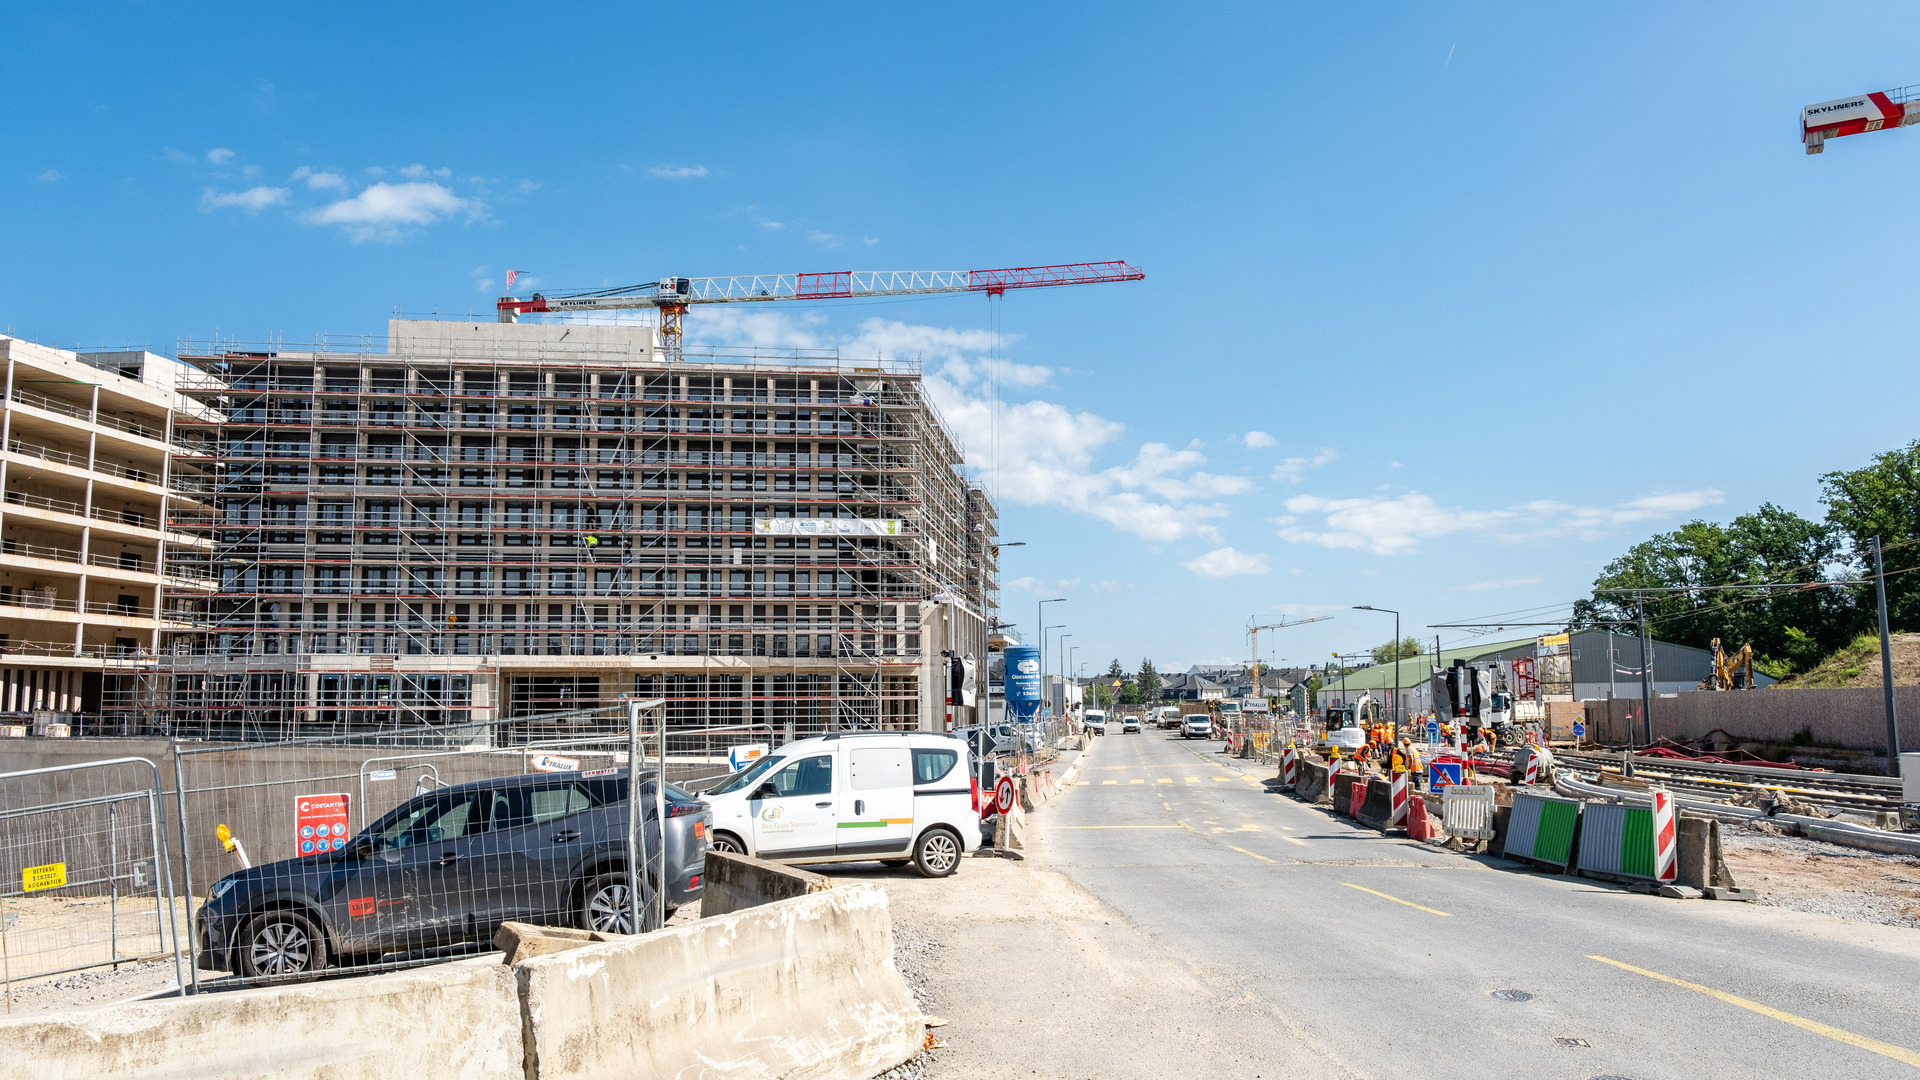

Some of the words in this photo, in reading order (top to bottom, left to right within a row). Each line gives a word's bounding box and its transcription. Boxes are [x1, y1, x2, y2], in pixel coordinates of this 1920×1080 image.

[1807, 100, 1865, 115] SKYLINERS
[548, 761, 573, 770] TRALUX
[33, 866, 55, 874] DEFENSE
[36, 879, 62, 887] CHANTIER
